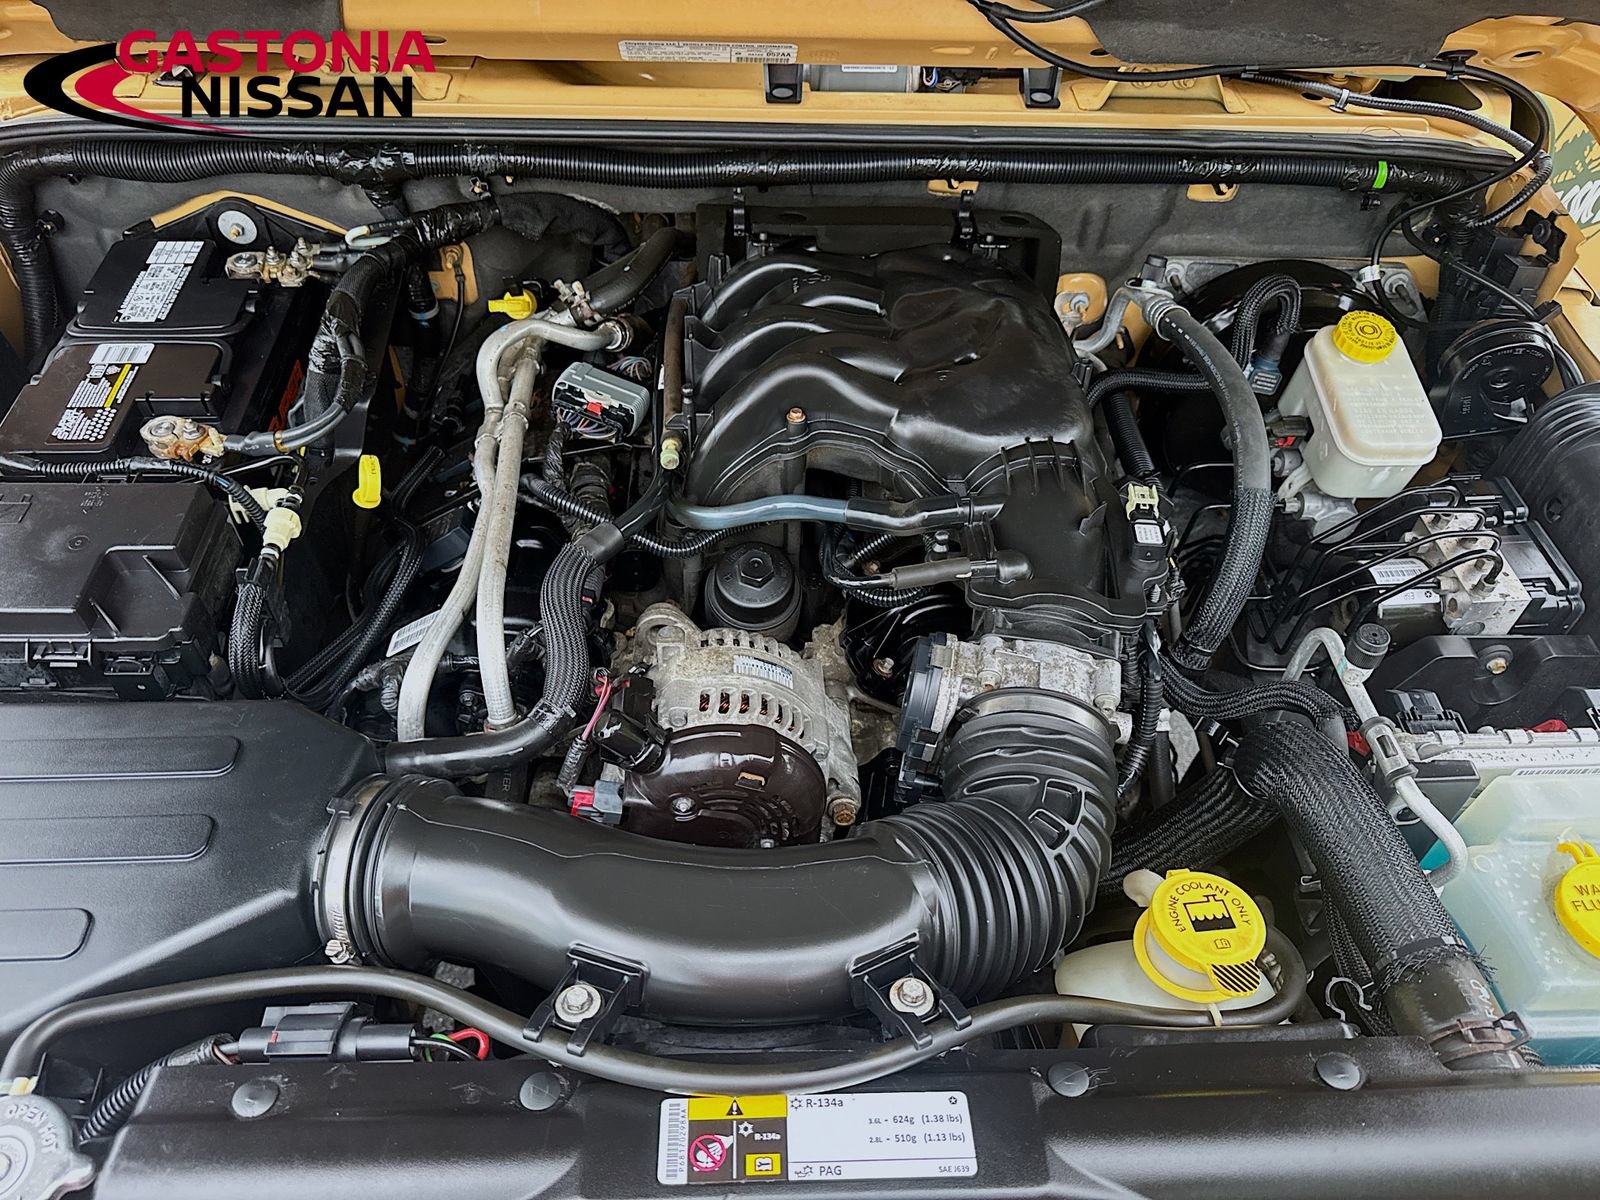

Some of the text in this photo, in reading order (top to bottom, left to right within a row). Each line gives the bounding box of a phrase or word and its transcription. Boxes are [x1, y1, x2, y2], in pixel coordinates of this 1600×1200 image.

[1168, 881, 1252, 933] ENGINE COOLANT ONLY
[805, 1098, 844, 1108] R-134a
[892, 1115, 915, 1125] 624g
[921, 1114, 945, 1125] (1.38
[946, 1114, 963, 1124] lbs)
[754, 1132, 781, 1141] R-134a
[894, 1134, 917, 1144] 510g
[923, 1133, 947, 1144] (1.13
[949, 1133, 966, 1143] lbs)
[818, 1165, 842, 1177] PAG
[954, 1165, 970, 1174] J639
